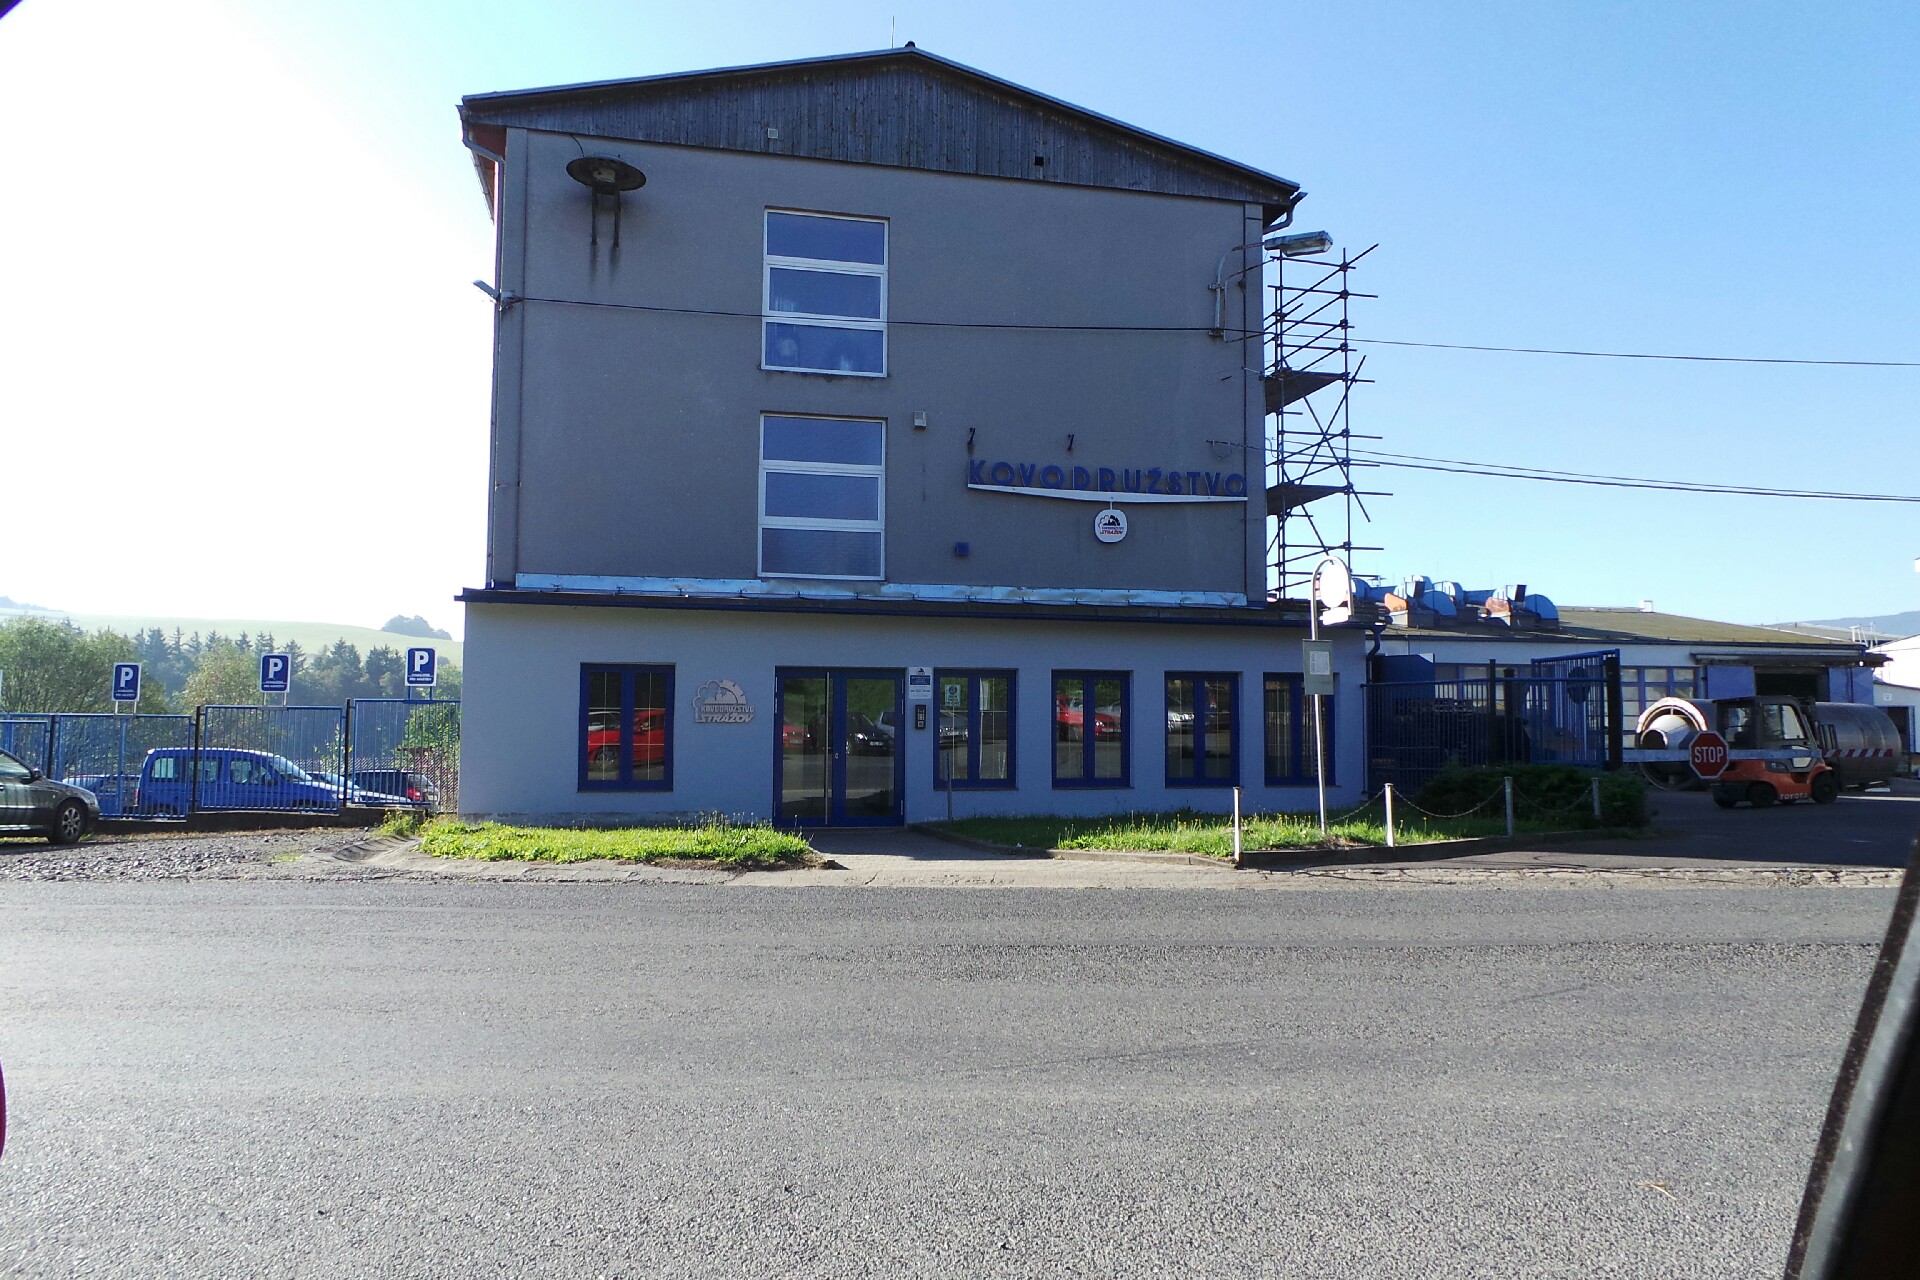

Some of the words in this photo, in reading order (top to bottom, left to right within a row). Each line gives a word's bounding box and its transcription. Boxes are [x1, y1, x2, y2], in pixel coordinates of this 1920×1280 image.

[967, 459, 1248, 497] KOVODRUŽSTVO
[268, 658, 283, 678] P
[414, 651, 429, 671] P
[120, 667, 134, 687] P
[1694, 746, 1724, 763] STOP
